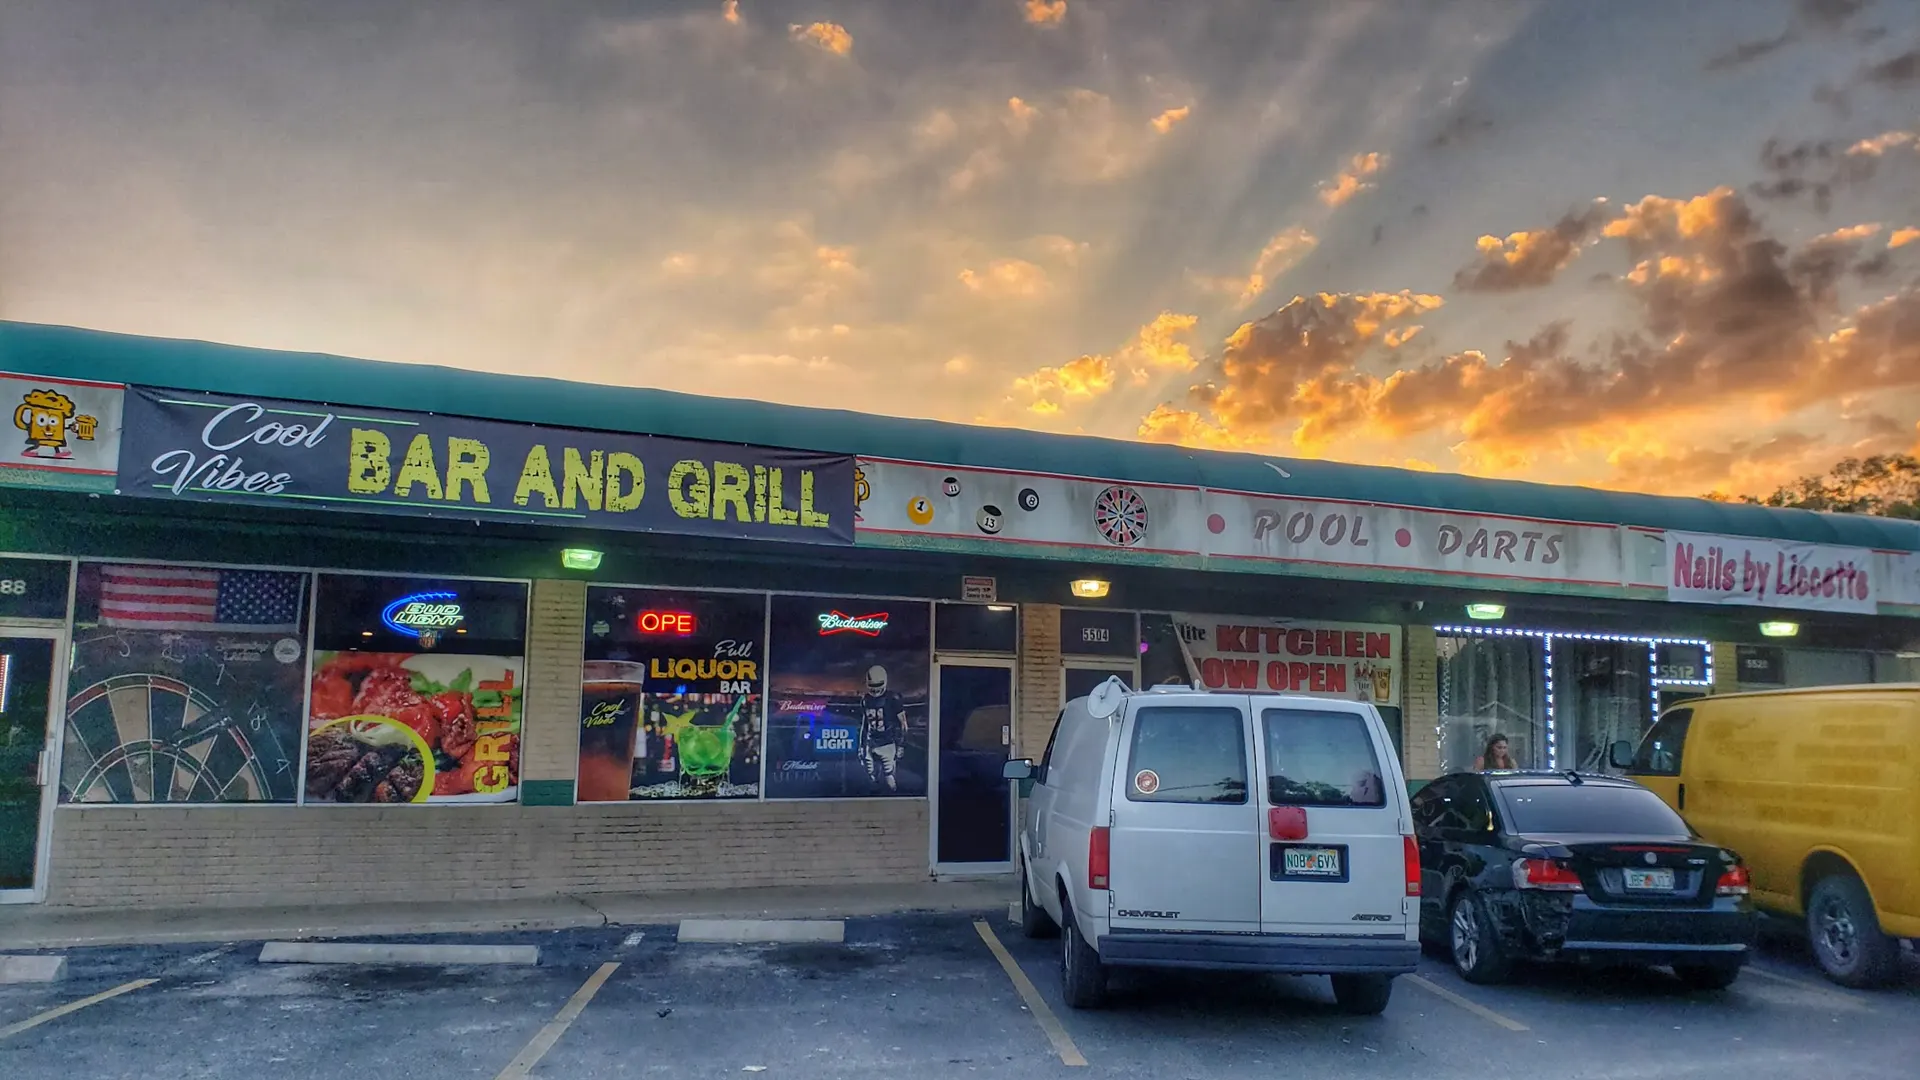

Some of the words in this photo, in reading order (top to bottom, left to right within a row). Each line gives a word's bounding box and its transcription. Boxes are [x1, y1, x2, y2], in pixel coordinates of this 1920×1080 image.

[201, 402, 336, 451] Cool
[151, 449, 293, 495] Vibes
[348, 427, 491, 504] BAR
[513, 444, 645, 513] AND
[668, 459, 830, 528] GRILL
[917, 501, 924, 511] 1
[1029, 496, 1035, 505] 8
[984, 517, 995, 528] 13
[1253, 509, 1369, 547] POOL
[1437, 524, 1563, 564] DARTS
[1674, 542, 1737, 591] Nails
[1743, 549, 1771, 601] by
[405, 602, 461, 616] BUD
[393, 611, 464, 626] LIGHT
[818, 613, 888, 629] Budweiser
[1082, 627, 1109, 642] 5504
[1216, 624, 1391, 659] KITCHEN
[713, 640, 754, 658] Full
[651, 658, 757, 680] LIQUOR
[1193, 658, 1259, 690] OW
[1266, 660, 1347, 693] OPEN
[1659, 664, 1695, 679] 5512
[720, 681, 751, 694] BAR
[591, 698, 625, 716] Cool
[779, 700, 826, 711] Budweiser
[583, 715, 616, 728] Vibes
[473, 669, 514, 794] GRILL
[821, 728, 849, 739] BUD
[816, 739, 854, 750] LIGHT
[1117, 909, 1181, 919] CHEVROLET
[1351, 913, 1392, 921] ASTRO
